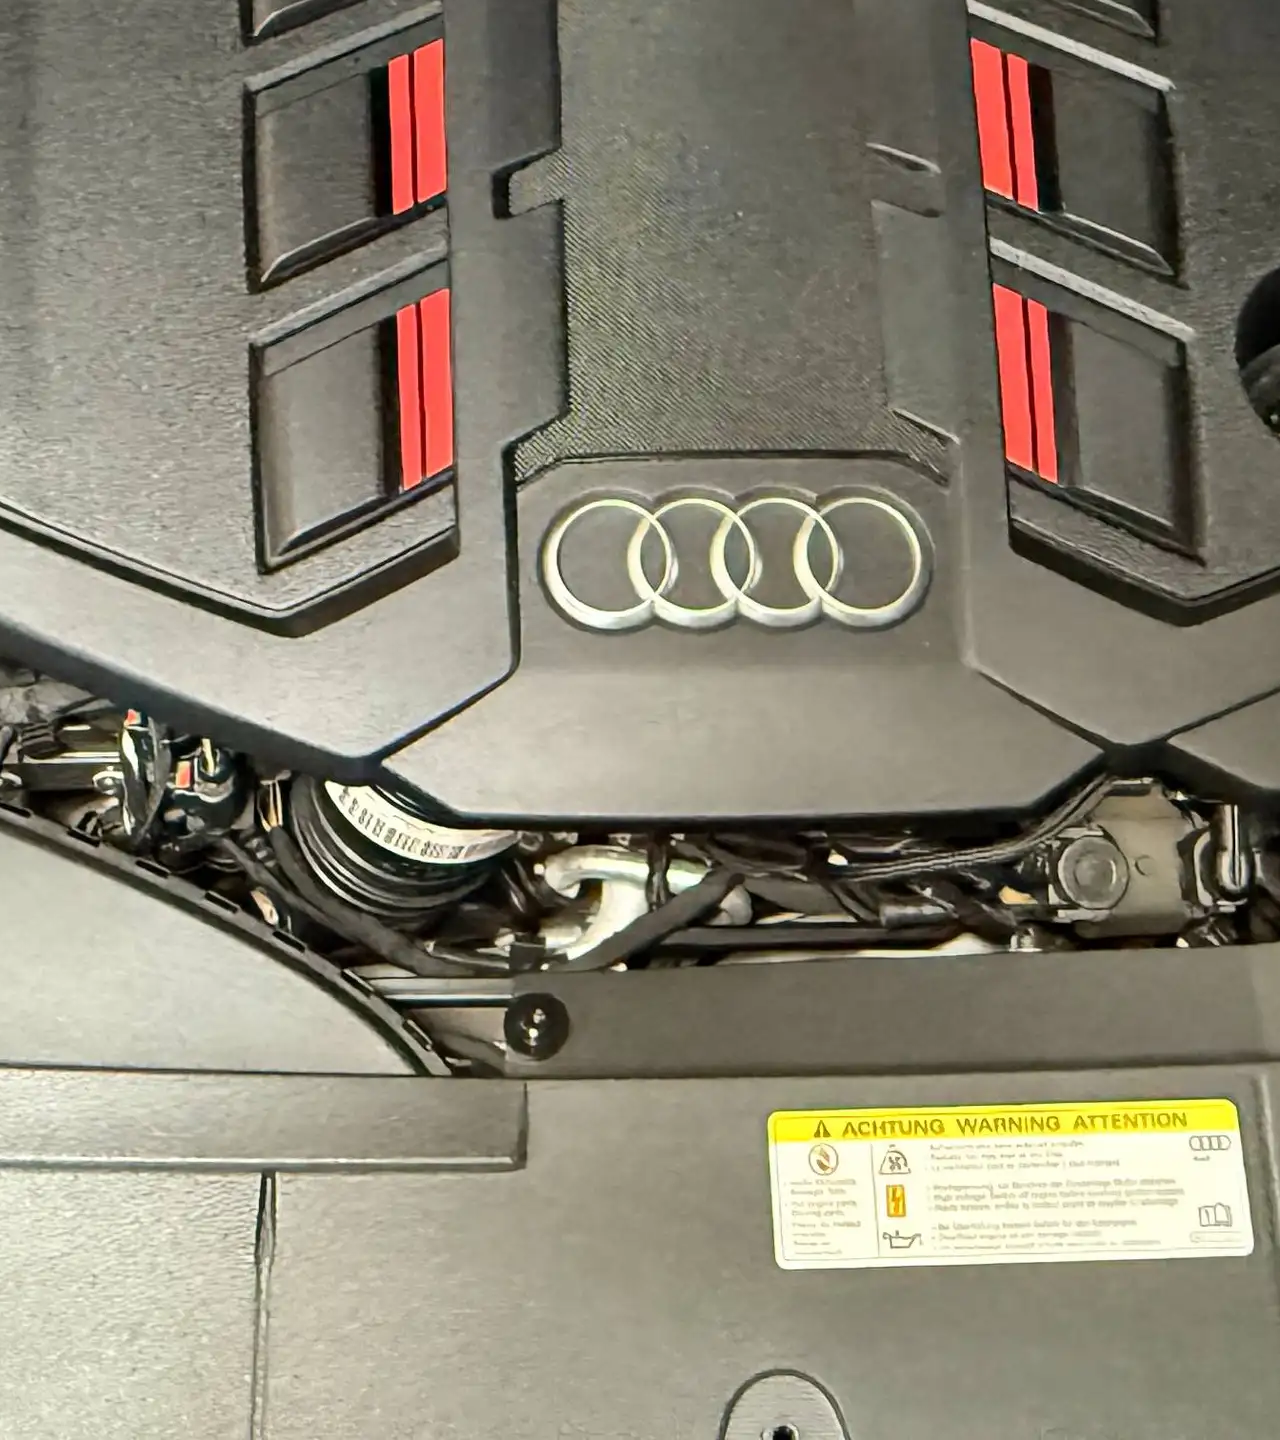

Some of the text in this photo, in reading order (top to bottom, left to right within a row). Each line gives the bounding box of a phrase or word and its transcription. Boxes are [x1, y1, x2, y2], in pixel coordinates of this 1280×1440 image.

[843, 1112, 1188, 1137] ACHTUNG WARNING ATTENTION
